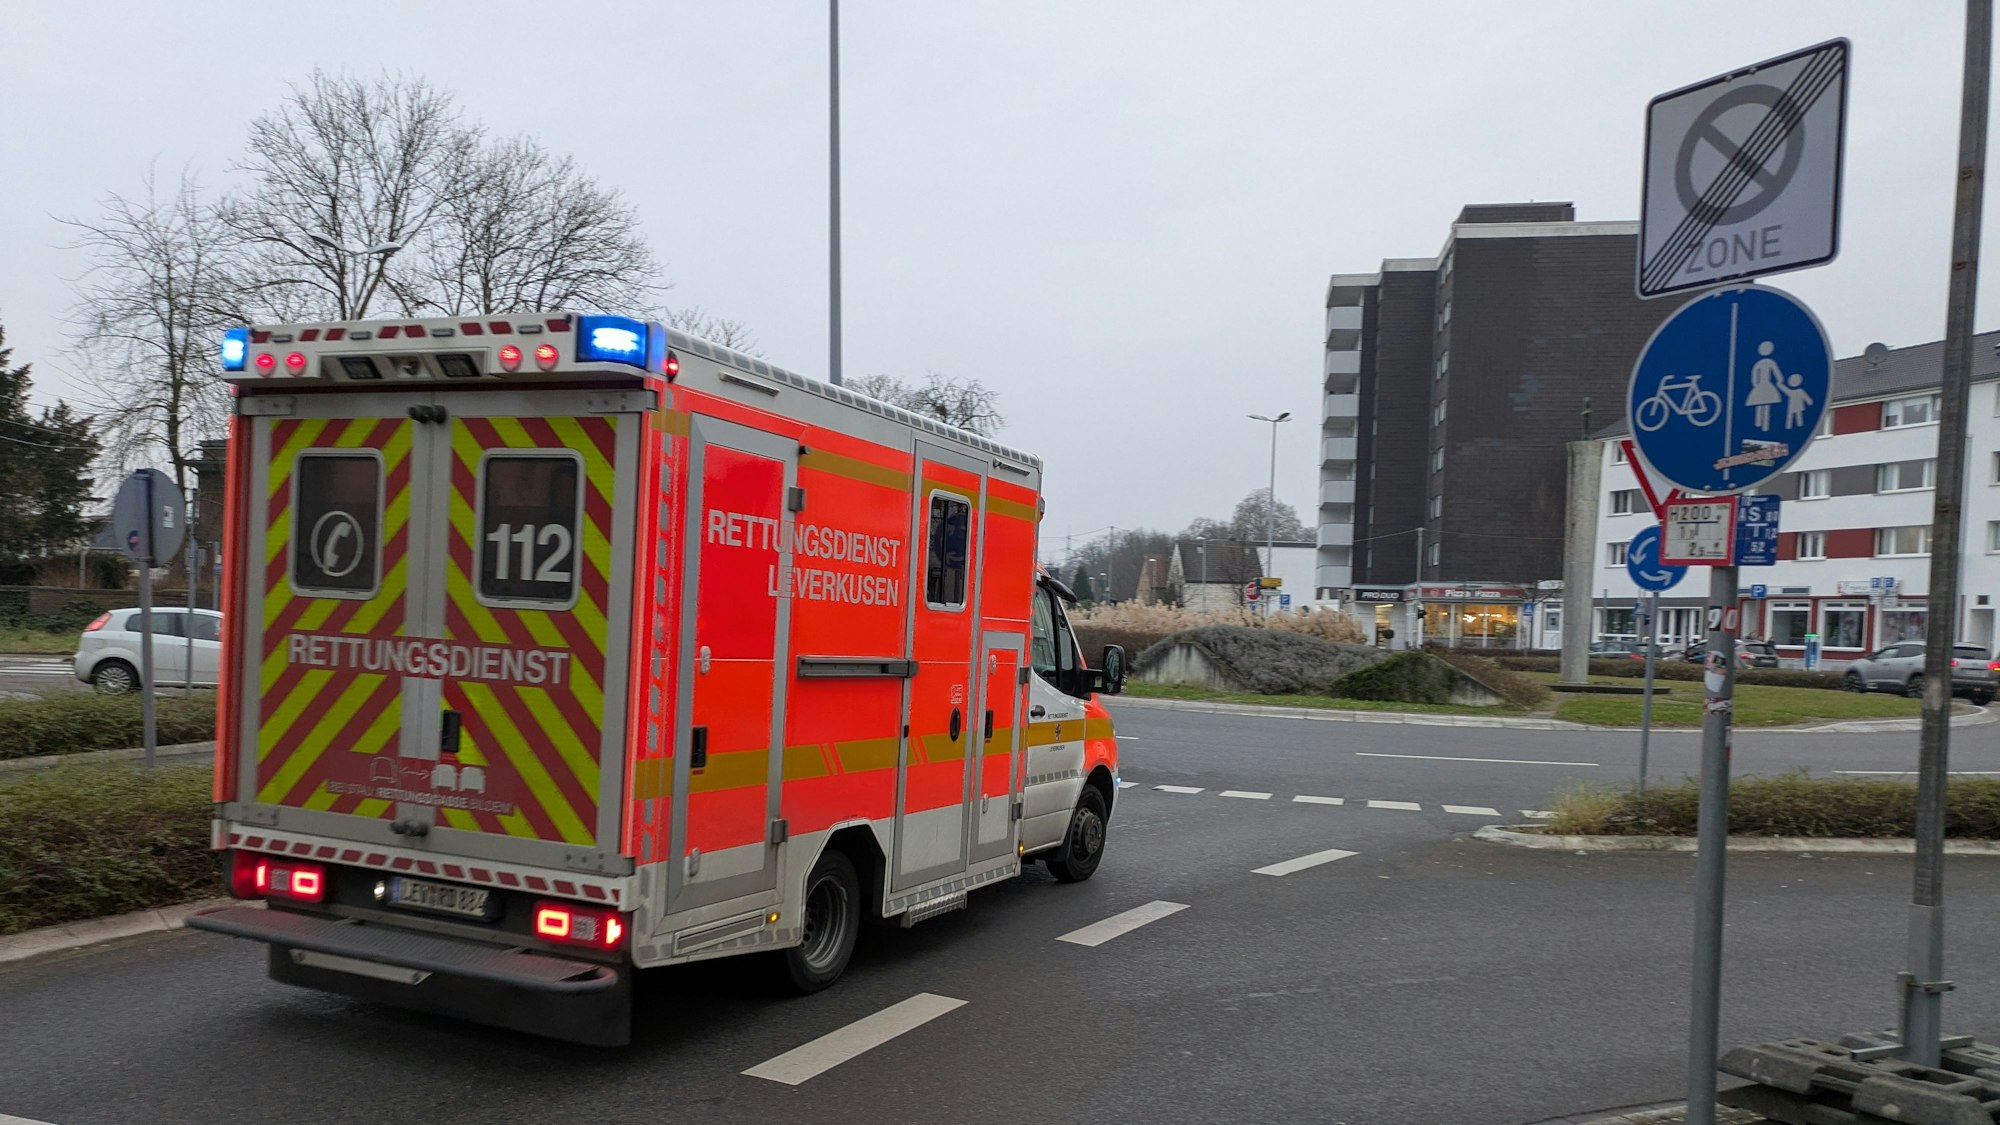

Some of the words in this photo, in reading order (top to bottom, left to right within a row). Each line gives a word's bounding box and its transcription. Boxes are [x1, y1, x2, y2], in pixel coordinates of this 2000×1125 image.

[1685, 224, 1783, 274] ZONE
[487, 523, 571, 582] 112
[708, 509, 900, 567] RETTUNGSDIENST
[768, 564, 899, 607] LEVERKUSEN
[288, 634, 569, 684] RETTUNGSDIENST
